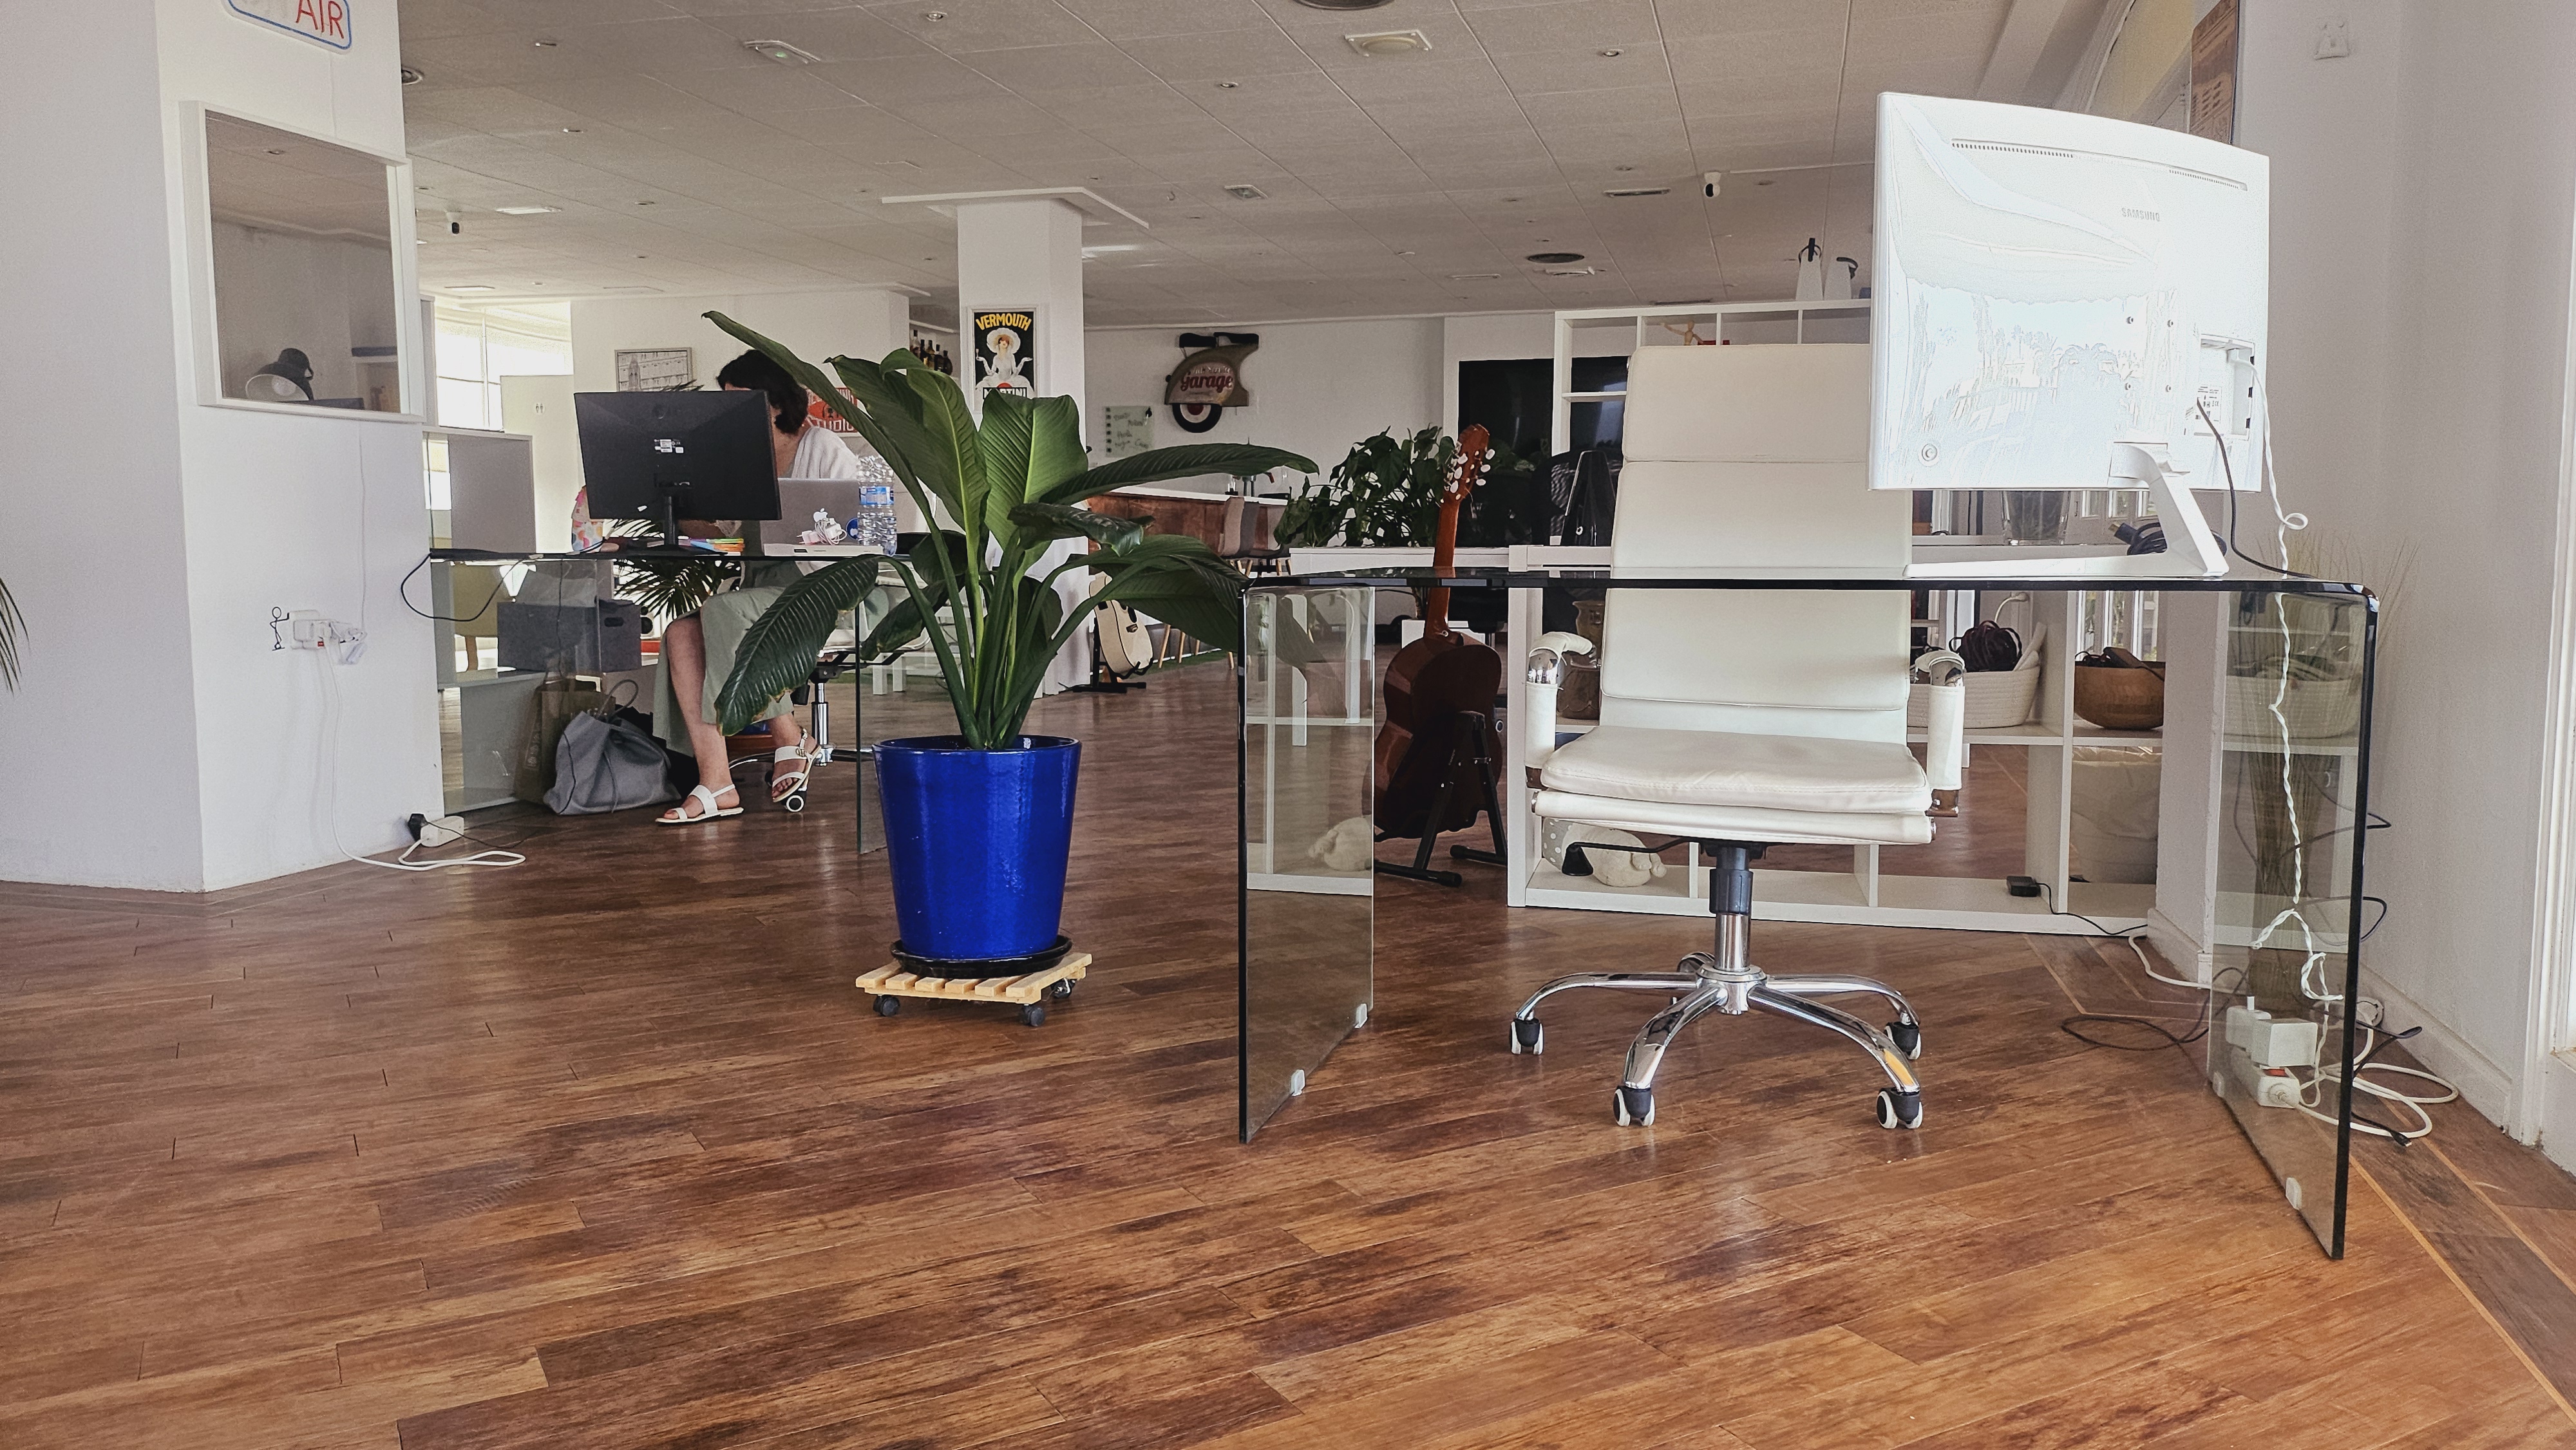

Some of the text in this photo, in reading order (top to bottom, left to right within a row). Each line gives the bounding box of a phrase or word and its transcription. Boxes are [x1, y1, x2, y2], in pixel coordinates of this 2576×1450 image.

[296, 0, 345, 39] AIR
[2121, 207, 2160, 221] SAMSUNG
[976, 313, 1032, 331] VERMOUTH
[983, 388, 1026, 399] MRTINI
